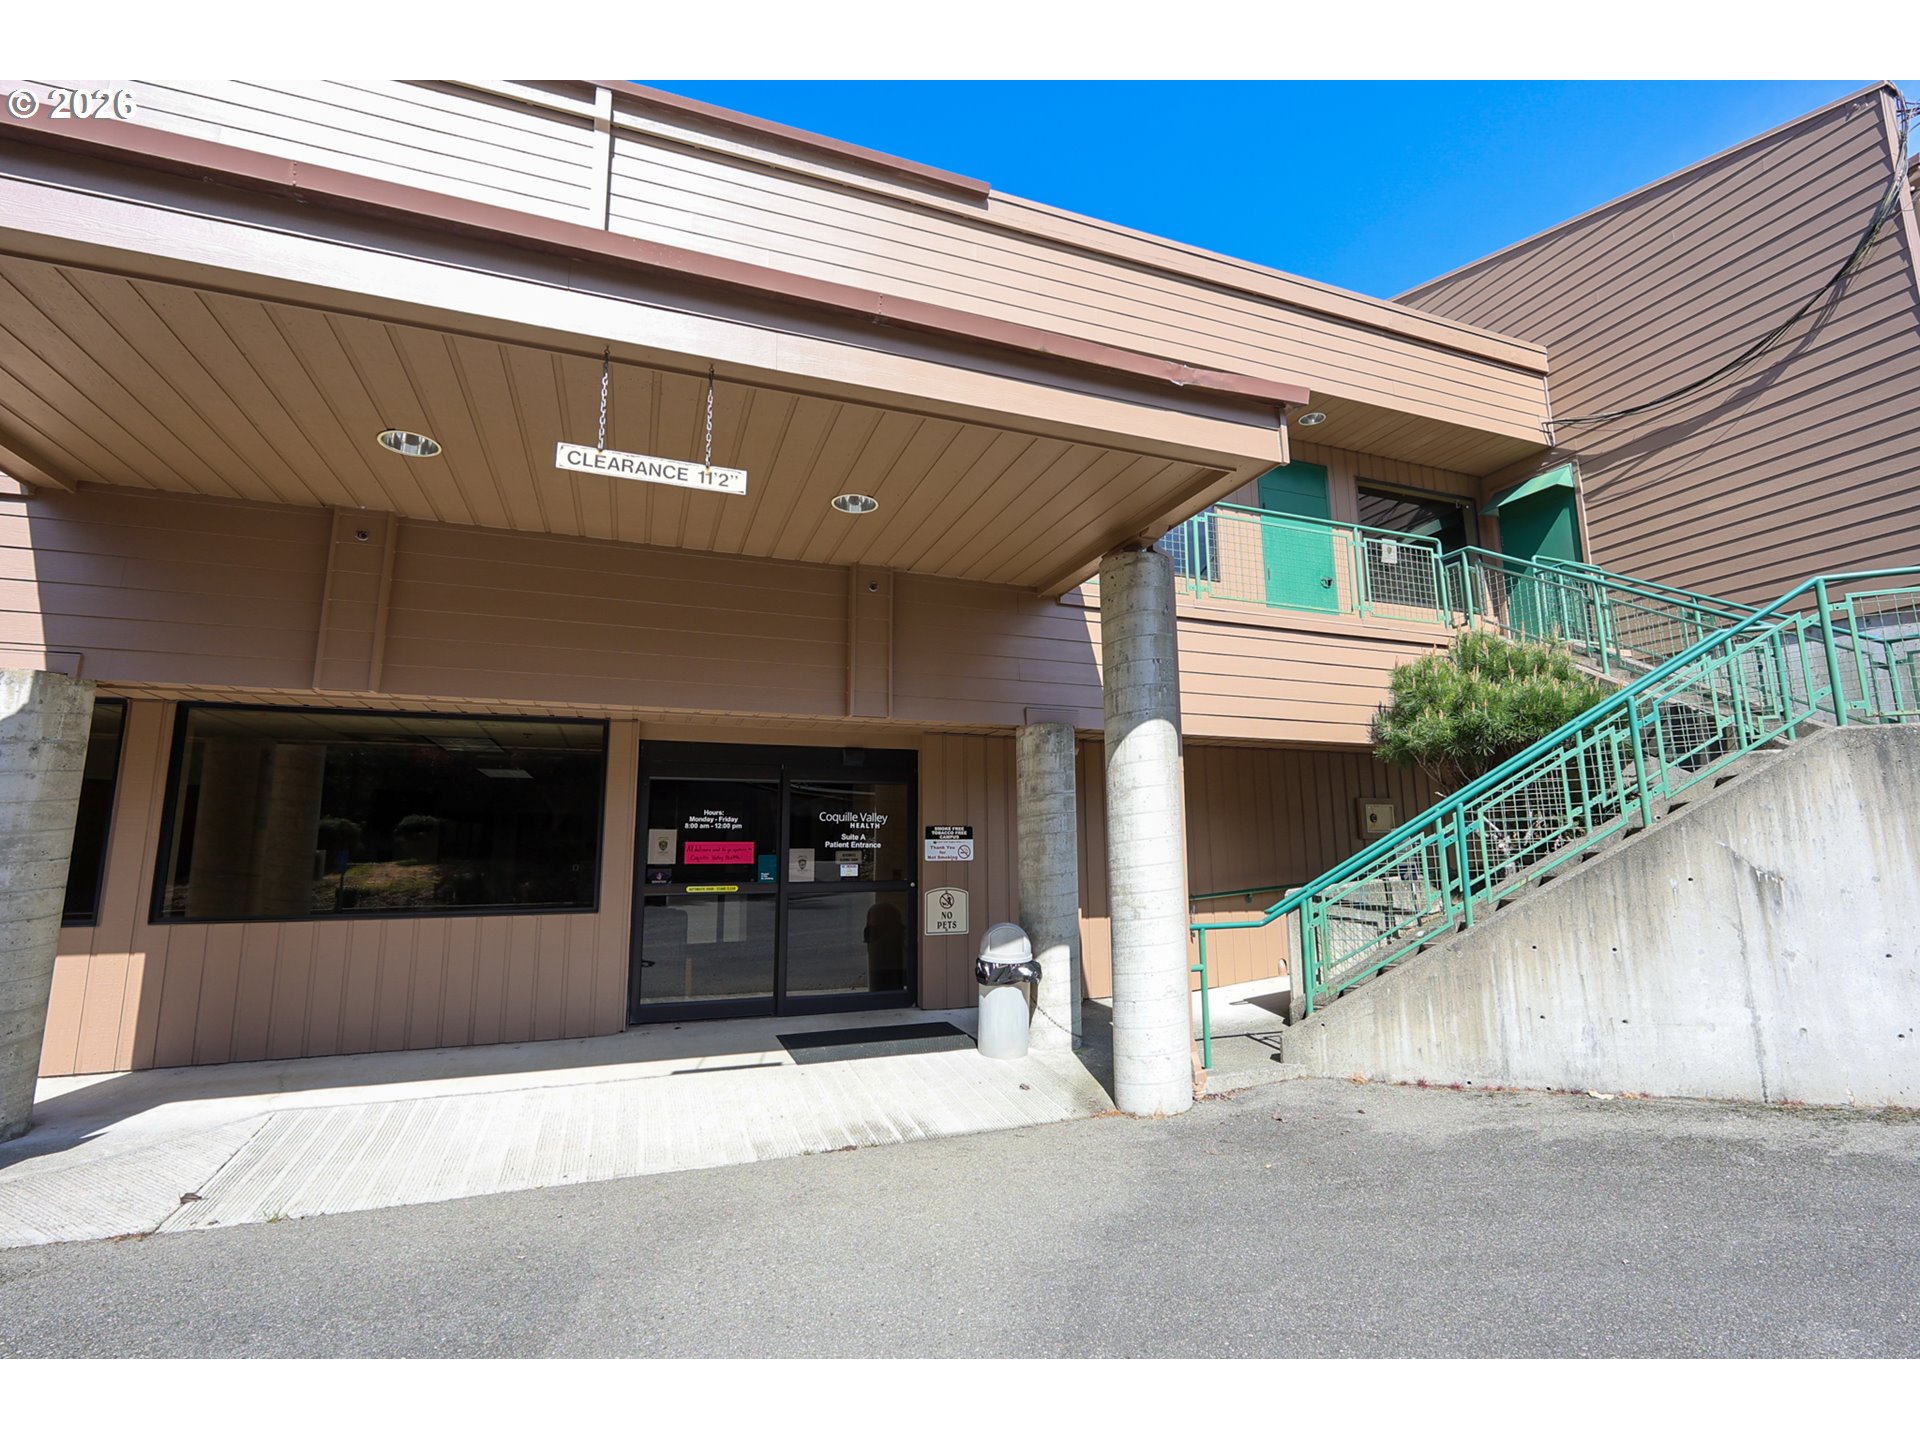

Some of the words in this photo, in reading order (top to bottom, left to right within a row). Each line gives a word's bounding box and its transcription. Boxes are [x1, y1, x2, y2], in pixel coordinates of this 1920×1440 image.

[567, 450, 689, 481] CLEARANCE
[819, 811, 858, 824] Coquille
[860, 812, 888, 825] Valley
[941, 911, 953, 919] NO
[937, 921, 957, 929] PETS
